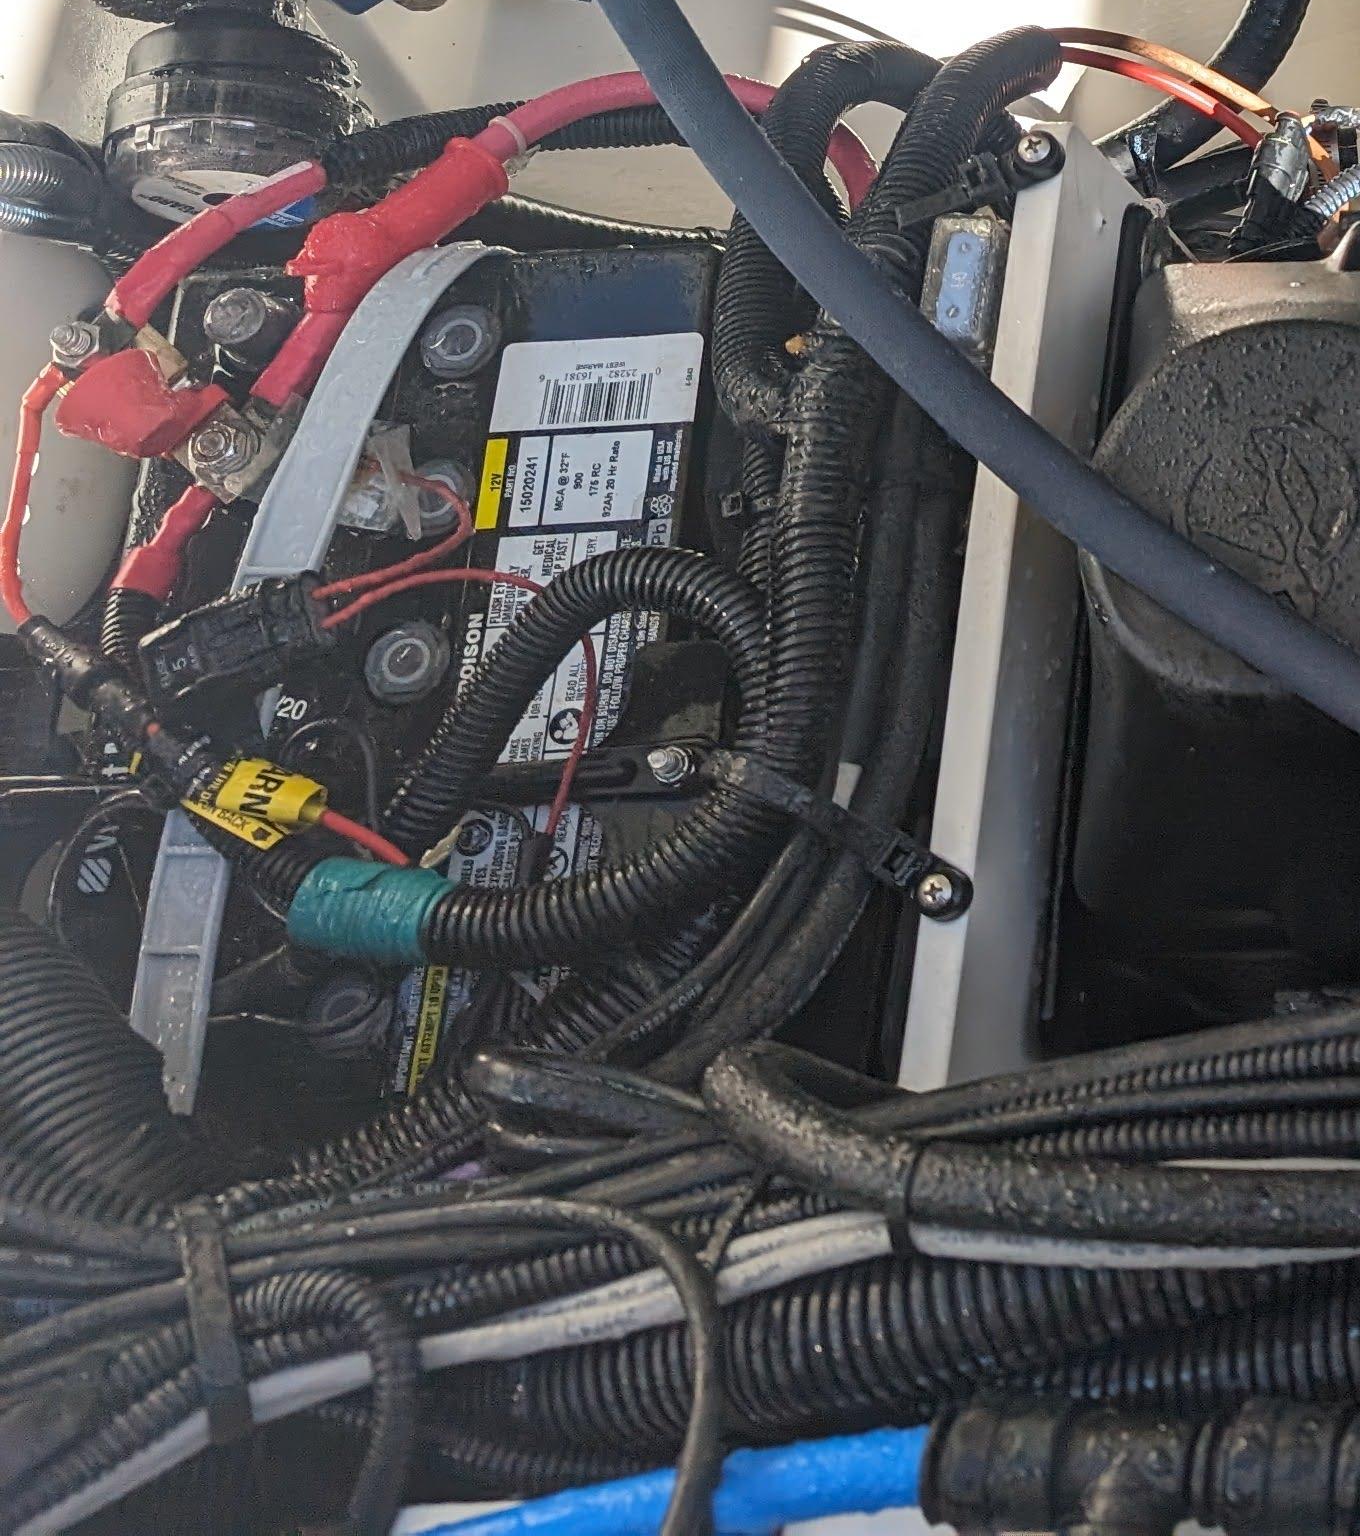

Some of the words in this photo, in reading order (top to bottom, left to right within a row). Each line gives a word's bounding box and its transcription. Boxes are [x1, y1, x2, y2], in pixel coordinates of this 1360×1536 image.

[564, 370, 593, 381] 16381
[611, 440, 621, 463] Rate
[591, 463, 602, 478] RC
[610, 463, 618, 477] Hr
[490, 473, 502, 493] 12V
[504, 480, 516, 498] PART
[520, 455, 539, 514] 15020241
[557, 475, 570, 486] @
[573, 472, 584, 490] 900
[607, 478, 616, 492] 20
[553, 487, 566, 512] MCA
[651, 522, 668, 547] Pb
[532, 540, 546, 556] GET
[541, 538, 557, 577] MEDICAL
[557, 538, 570, 559] FAST.
[569, 662, 581, 679] ALL
[605, 655, 617, 672] NOT
[616, 645, 628, 679] PROPER
[565, 681, 577, 702] READ
[610, 680, 623, 712] FOLLOW
